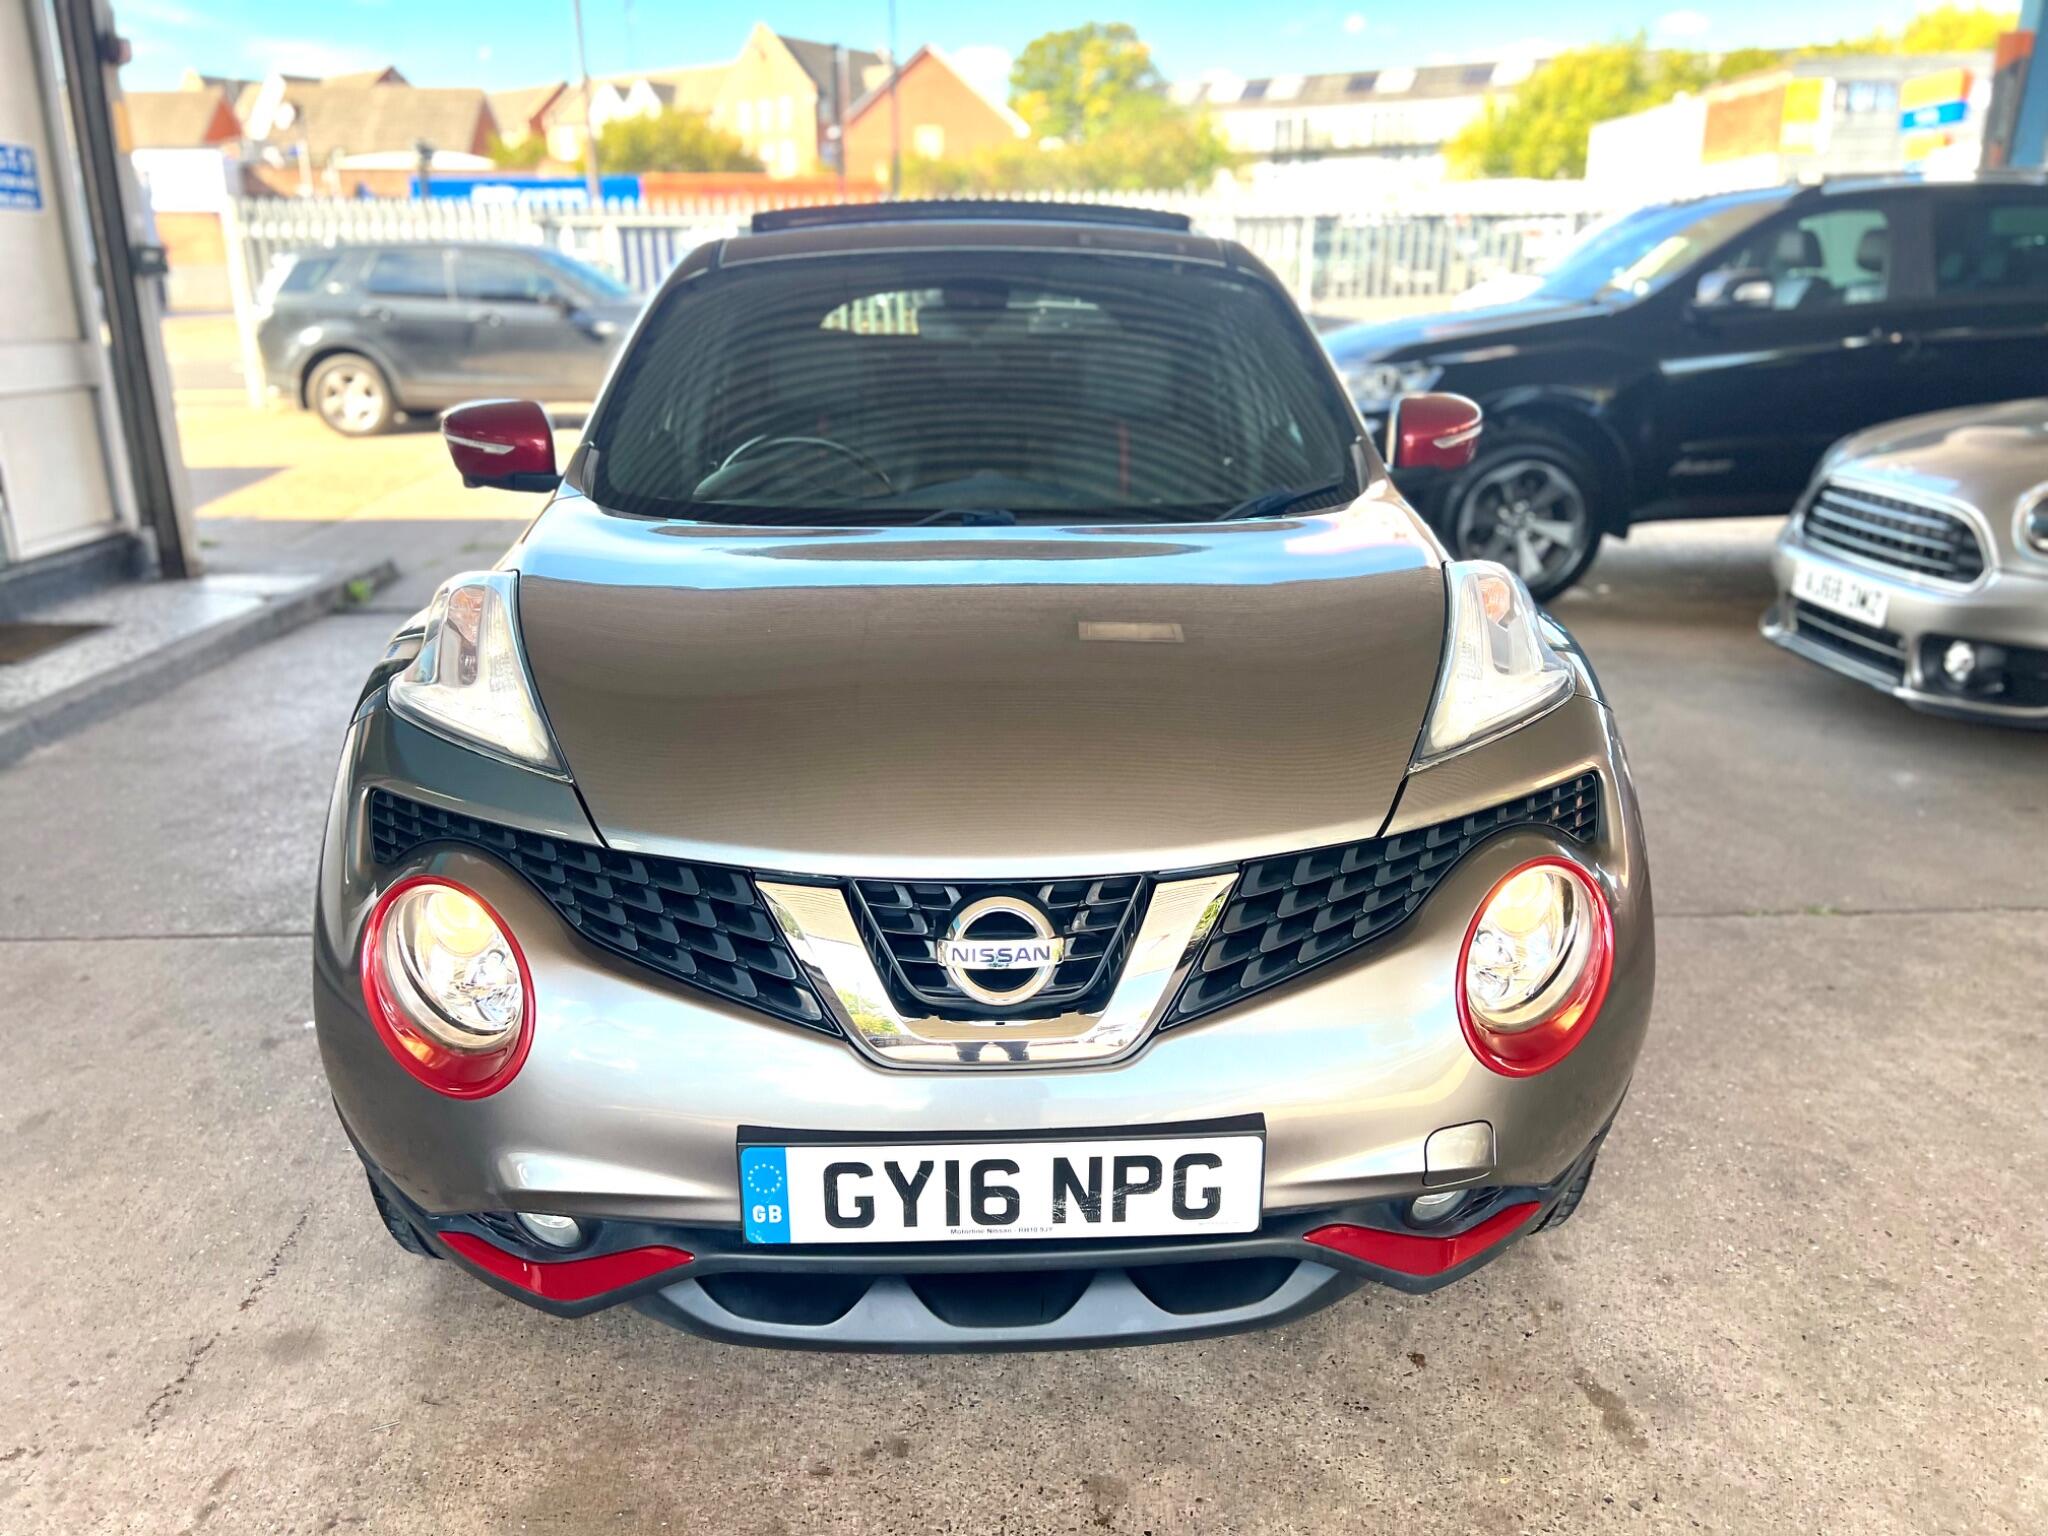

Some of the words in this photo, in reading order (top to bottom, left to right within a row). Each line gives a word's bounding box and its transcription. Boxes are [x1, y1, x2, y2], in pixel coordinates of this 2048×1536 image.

[951, 945, 1051, 963] NISSAN
[823, 1158, 1021, 1229] GY16
[1052, 1152, 1223, 1224] NPG
[752, 1204, 783, 1224] GB
